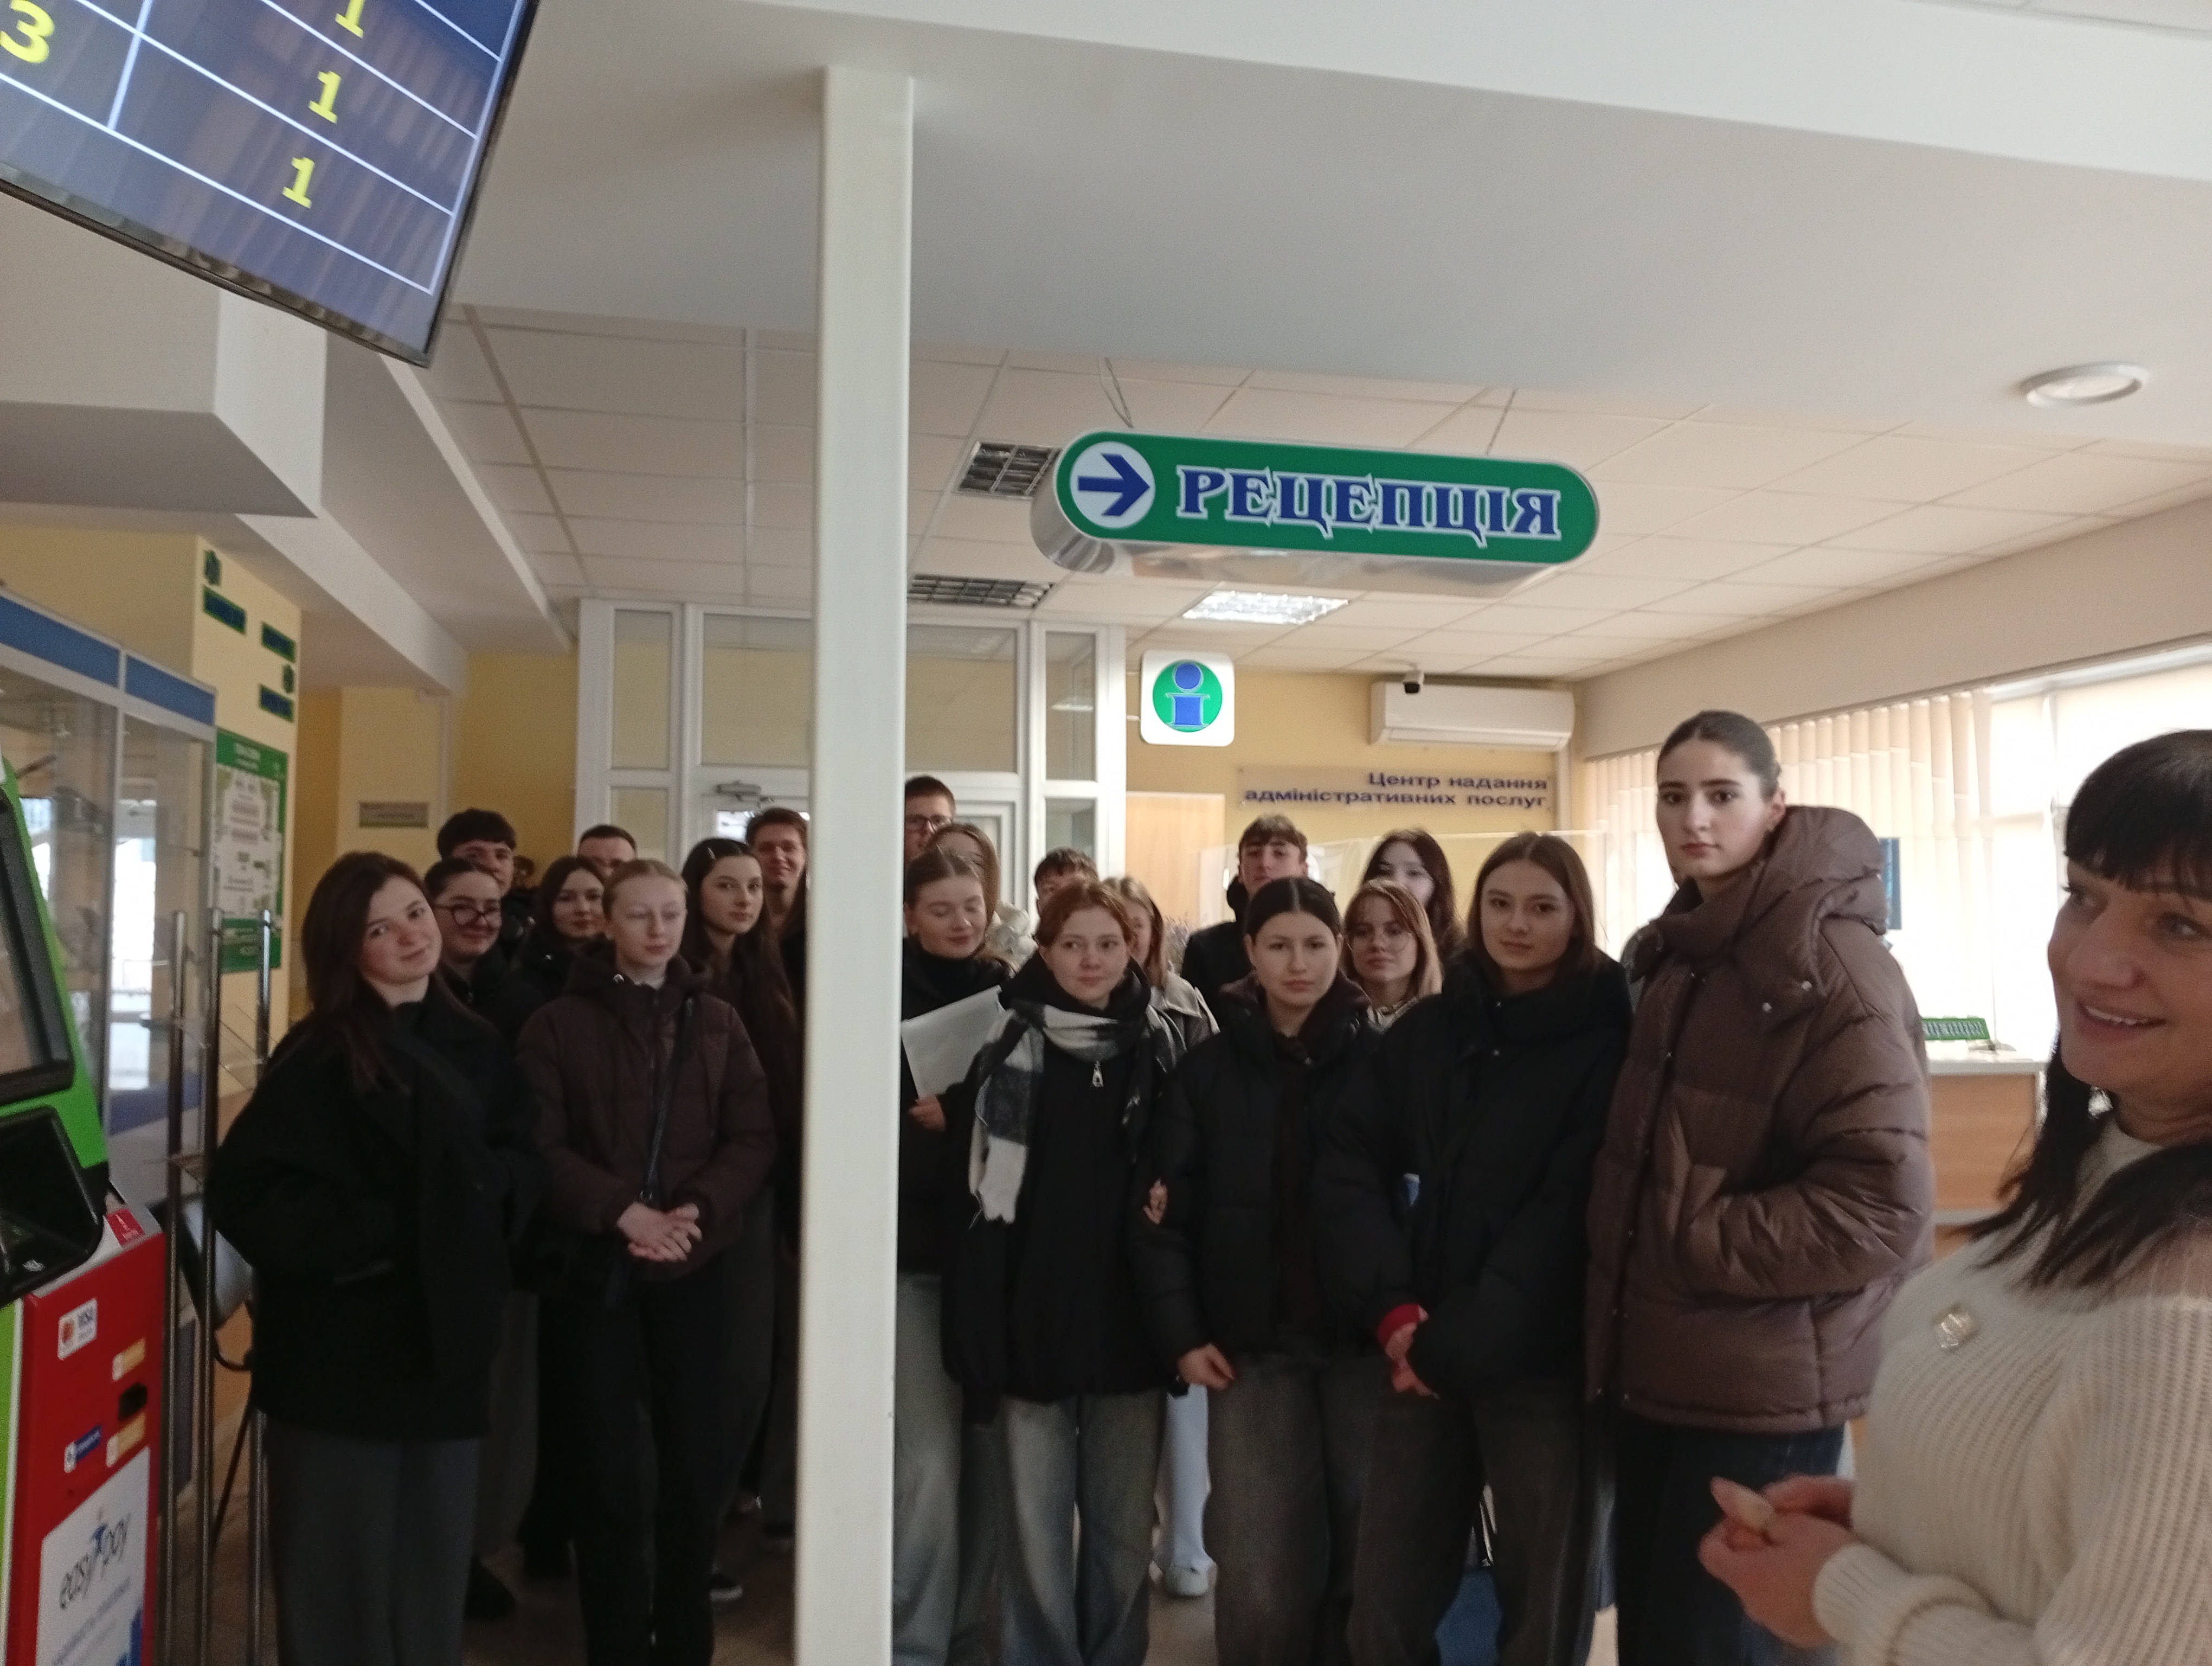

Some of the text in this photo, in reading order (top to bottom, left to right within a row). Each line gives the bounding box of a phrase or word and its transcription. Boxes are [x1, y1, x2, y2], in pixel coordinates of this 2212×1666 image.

[0, 0, 55, 63] 3
[336, 0, 364, 38] 1
[309, 71, 341, 124] 1
[282, 157, 314, 208] 1
[1176, 465, 1562, 548] РЕЦЕПЦІЯ
[1245, 788, 1546, 809] адміністративних послуг
[1368, 772, 1547, 789] Центр надання
